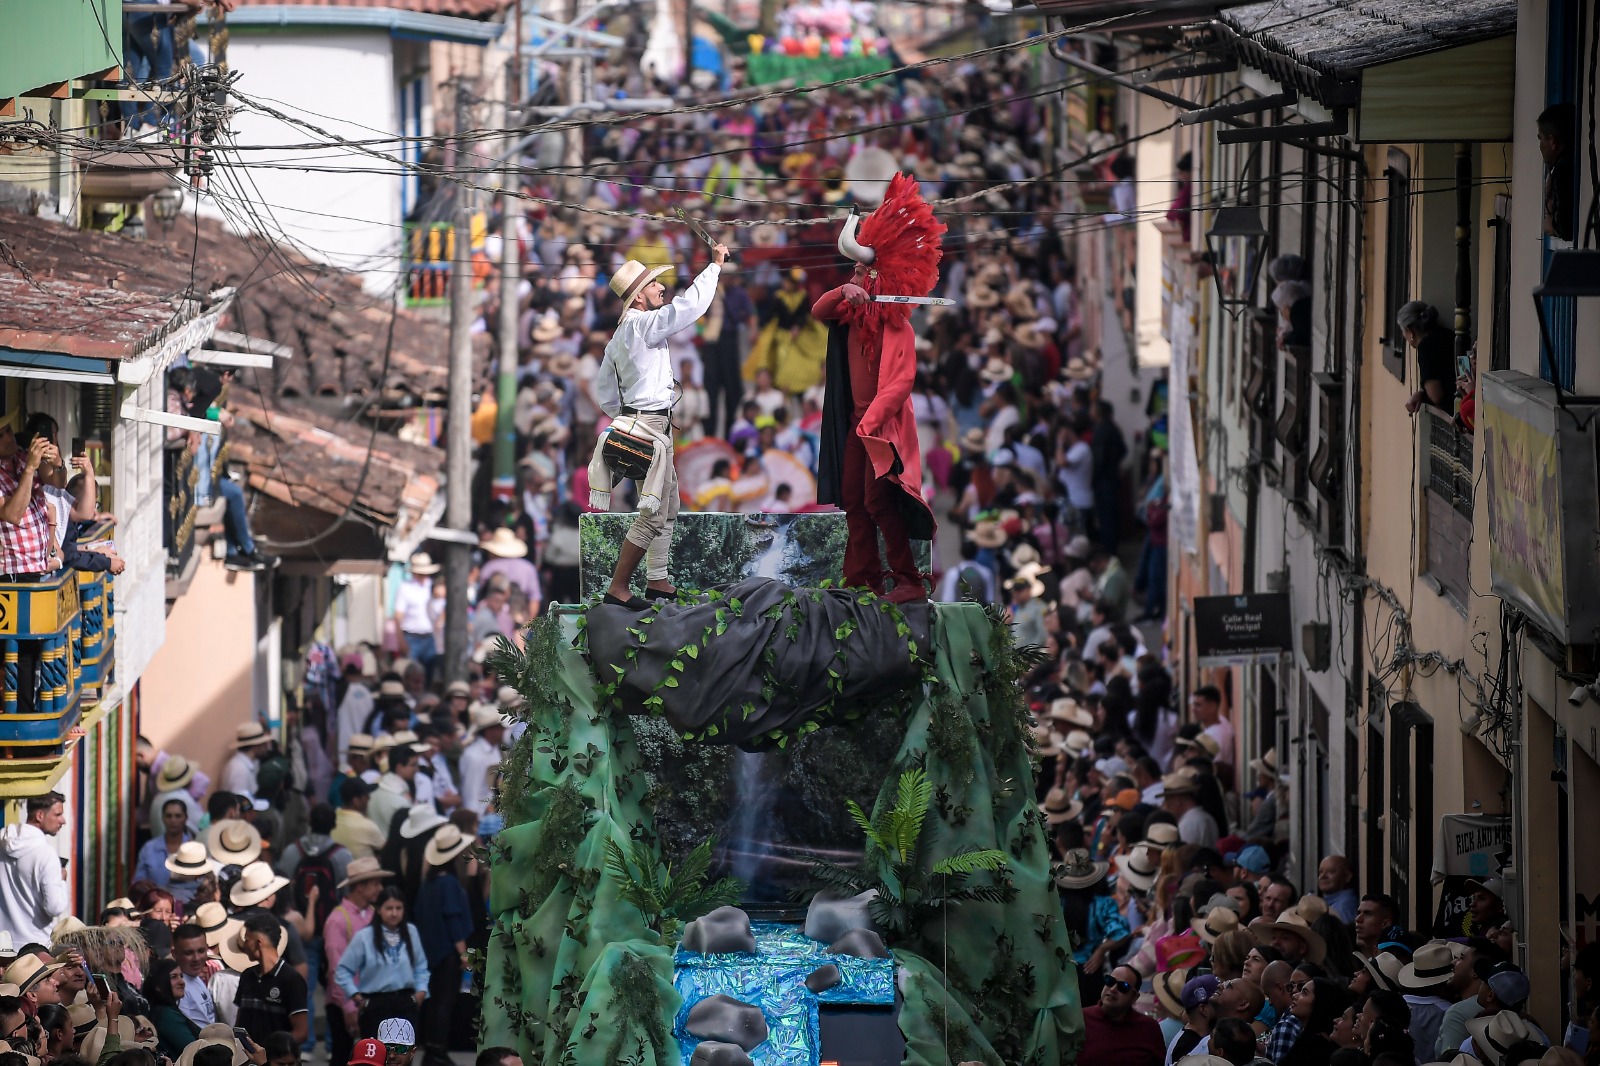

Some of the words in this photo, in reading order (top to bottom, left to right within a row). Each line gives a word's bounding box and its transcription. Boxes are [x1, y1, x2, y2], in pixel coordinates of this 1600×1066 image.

[1222, 614, 1242, 623] Calle
[1245, 612, 1262, 621] Real
[1225, 622, 1260, 632] Principal
[1456, 831, 1475, 855] RICK
[1477, 827, 1492, 849] AND
[364, 1043, 377, 1058] B
